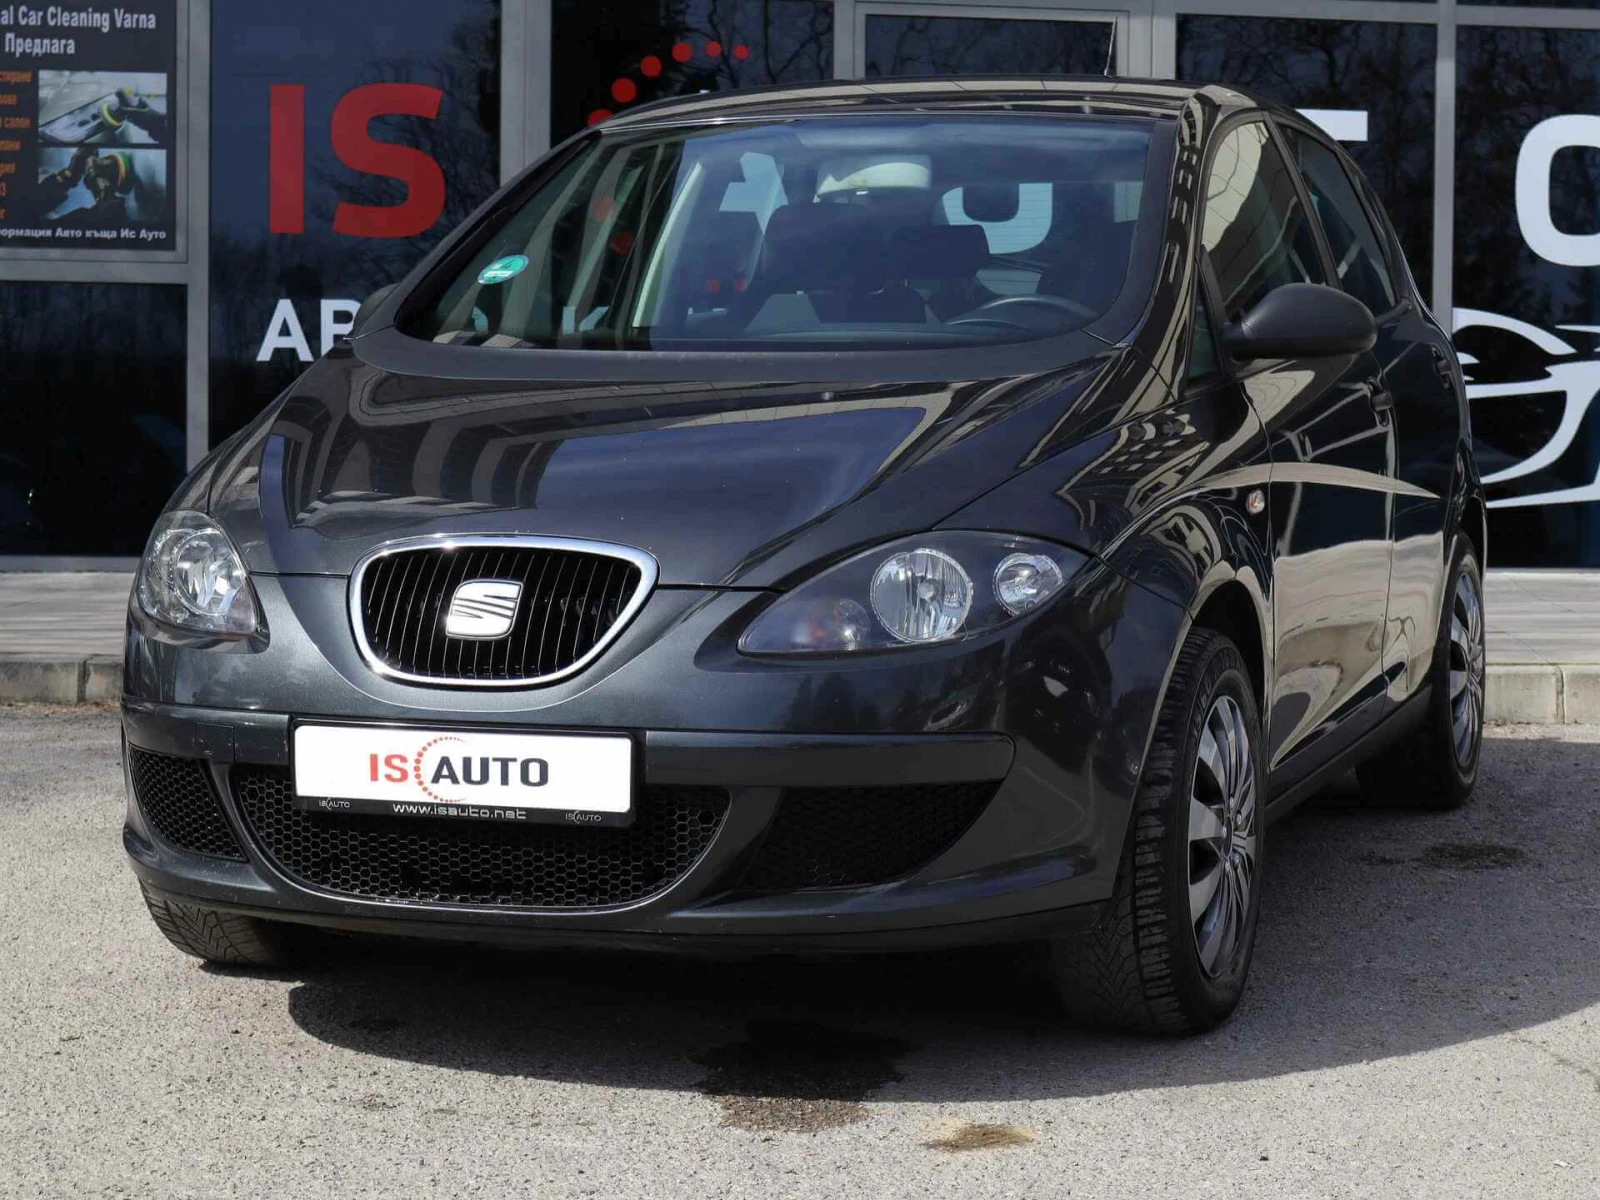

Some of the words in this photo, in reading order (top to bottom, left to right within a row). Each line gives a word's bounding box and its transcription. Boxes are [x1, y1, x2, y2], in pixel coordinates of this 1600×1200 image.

[18, 5, 44, 26] Car
[47, 7, 110, 33] Cleaning
[114, 8, 157, 29] Varna
[5, 33, 76, 57] Предлага
[268, 82, 447, 239] IS
[0, 228, 53, 239] ормация
[55, 227, 82, 238] Авто
[120, 228, 136, 239] Ис
[139, 228, 167, 241] Ауто
[369, 753, 409, 783] IS
[430, 755, 549, 787] AUTO
[392, 803, 527, 819] www.isauto.net
